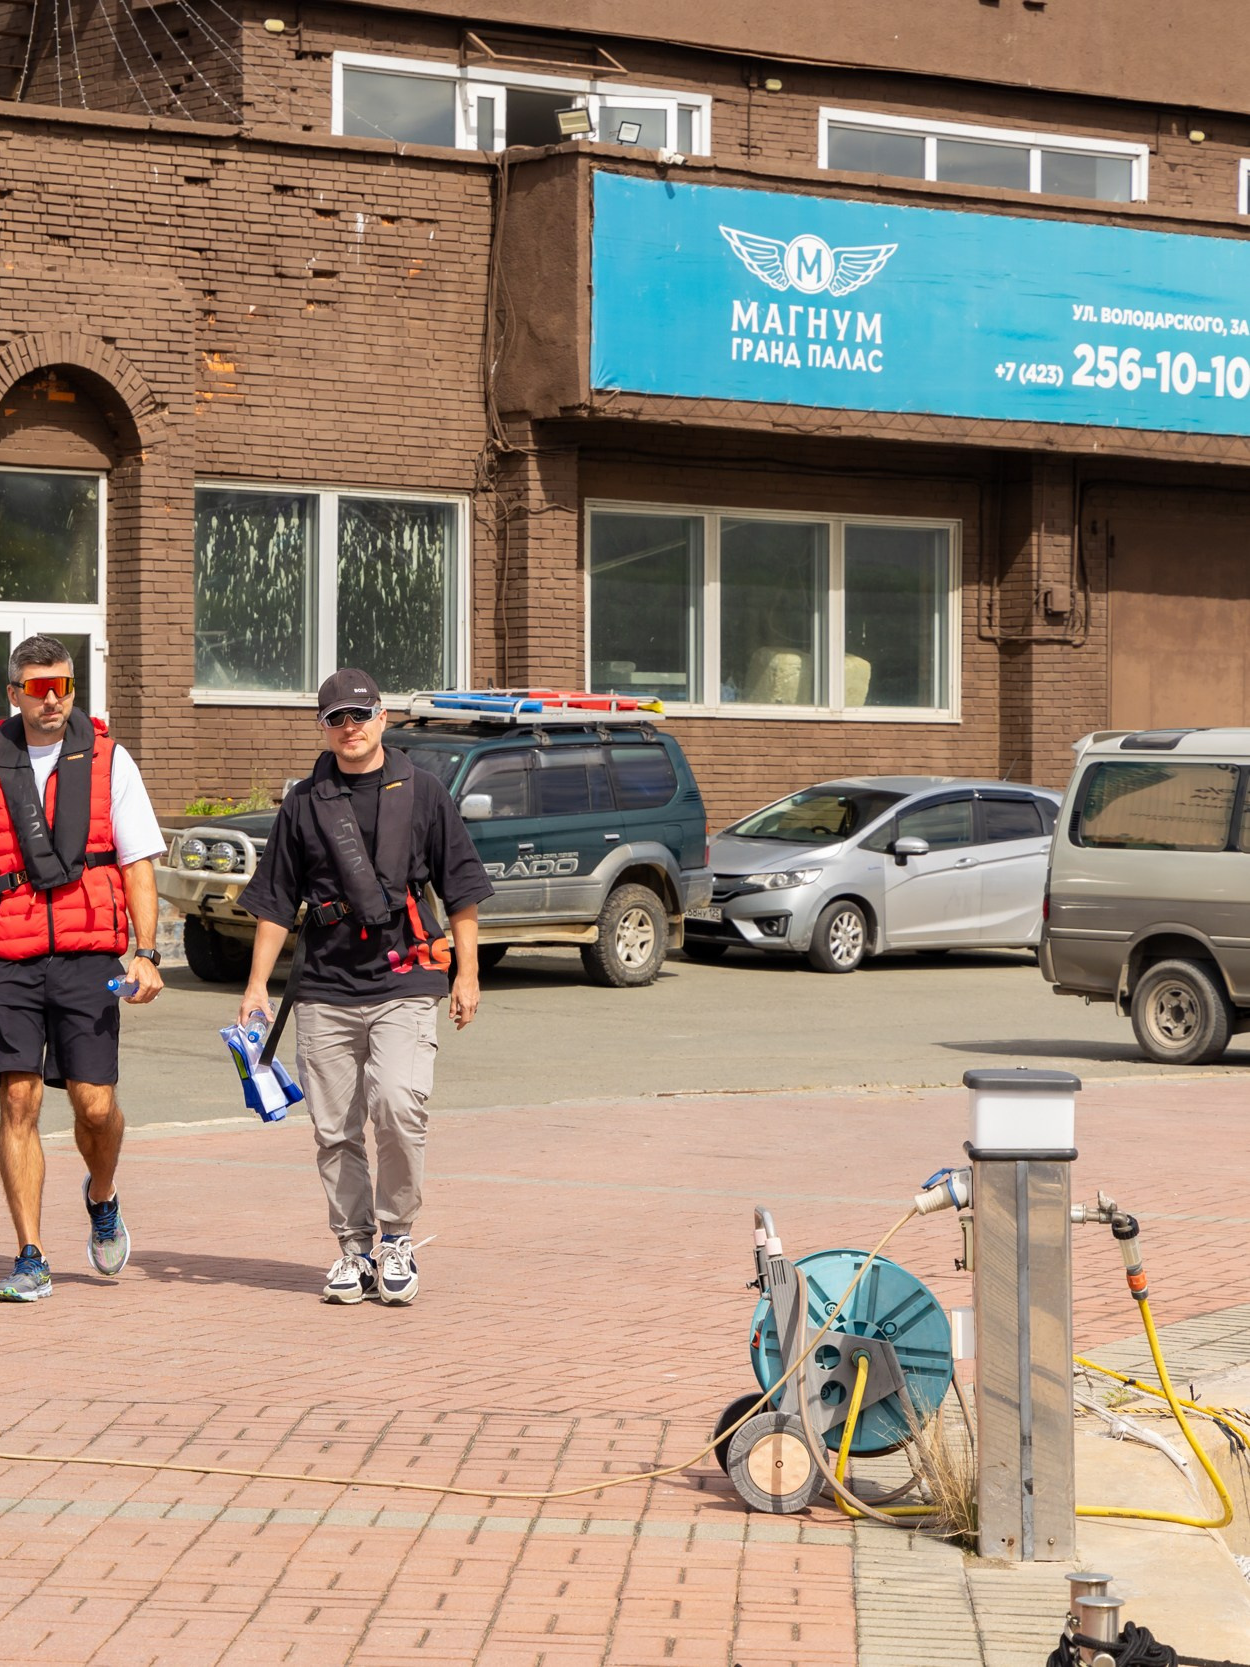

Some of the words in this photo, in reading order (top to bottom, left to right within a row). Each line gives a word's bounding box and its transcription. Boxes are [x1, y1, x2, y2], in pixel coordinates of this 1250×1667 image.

[731, 300, 882, 345] МАГНУМ
[1072, 304, 1098, 323] УЛ.
[1100, 307, 1228, 337] ВОЛОДАРСКОГО,
[731, 337, 801, 369] ГРАНД
[808, 344, 884, 373] ПАЛАС
[995, 361, 1016, 382] +7
[1018, 362, 1064, 388] (423)
[1071, 343, 1250, 400] 256-10-10
[483, 858, 579, 878] RADO
